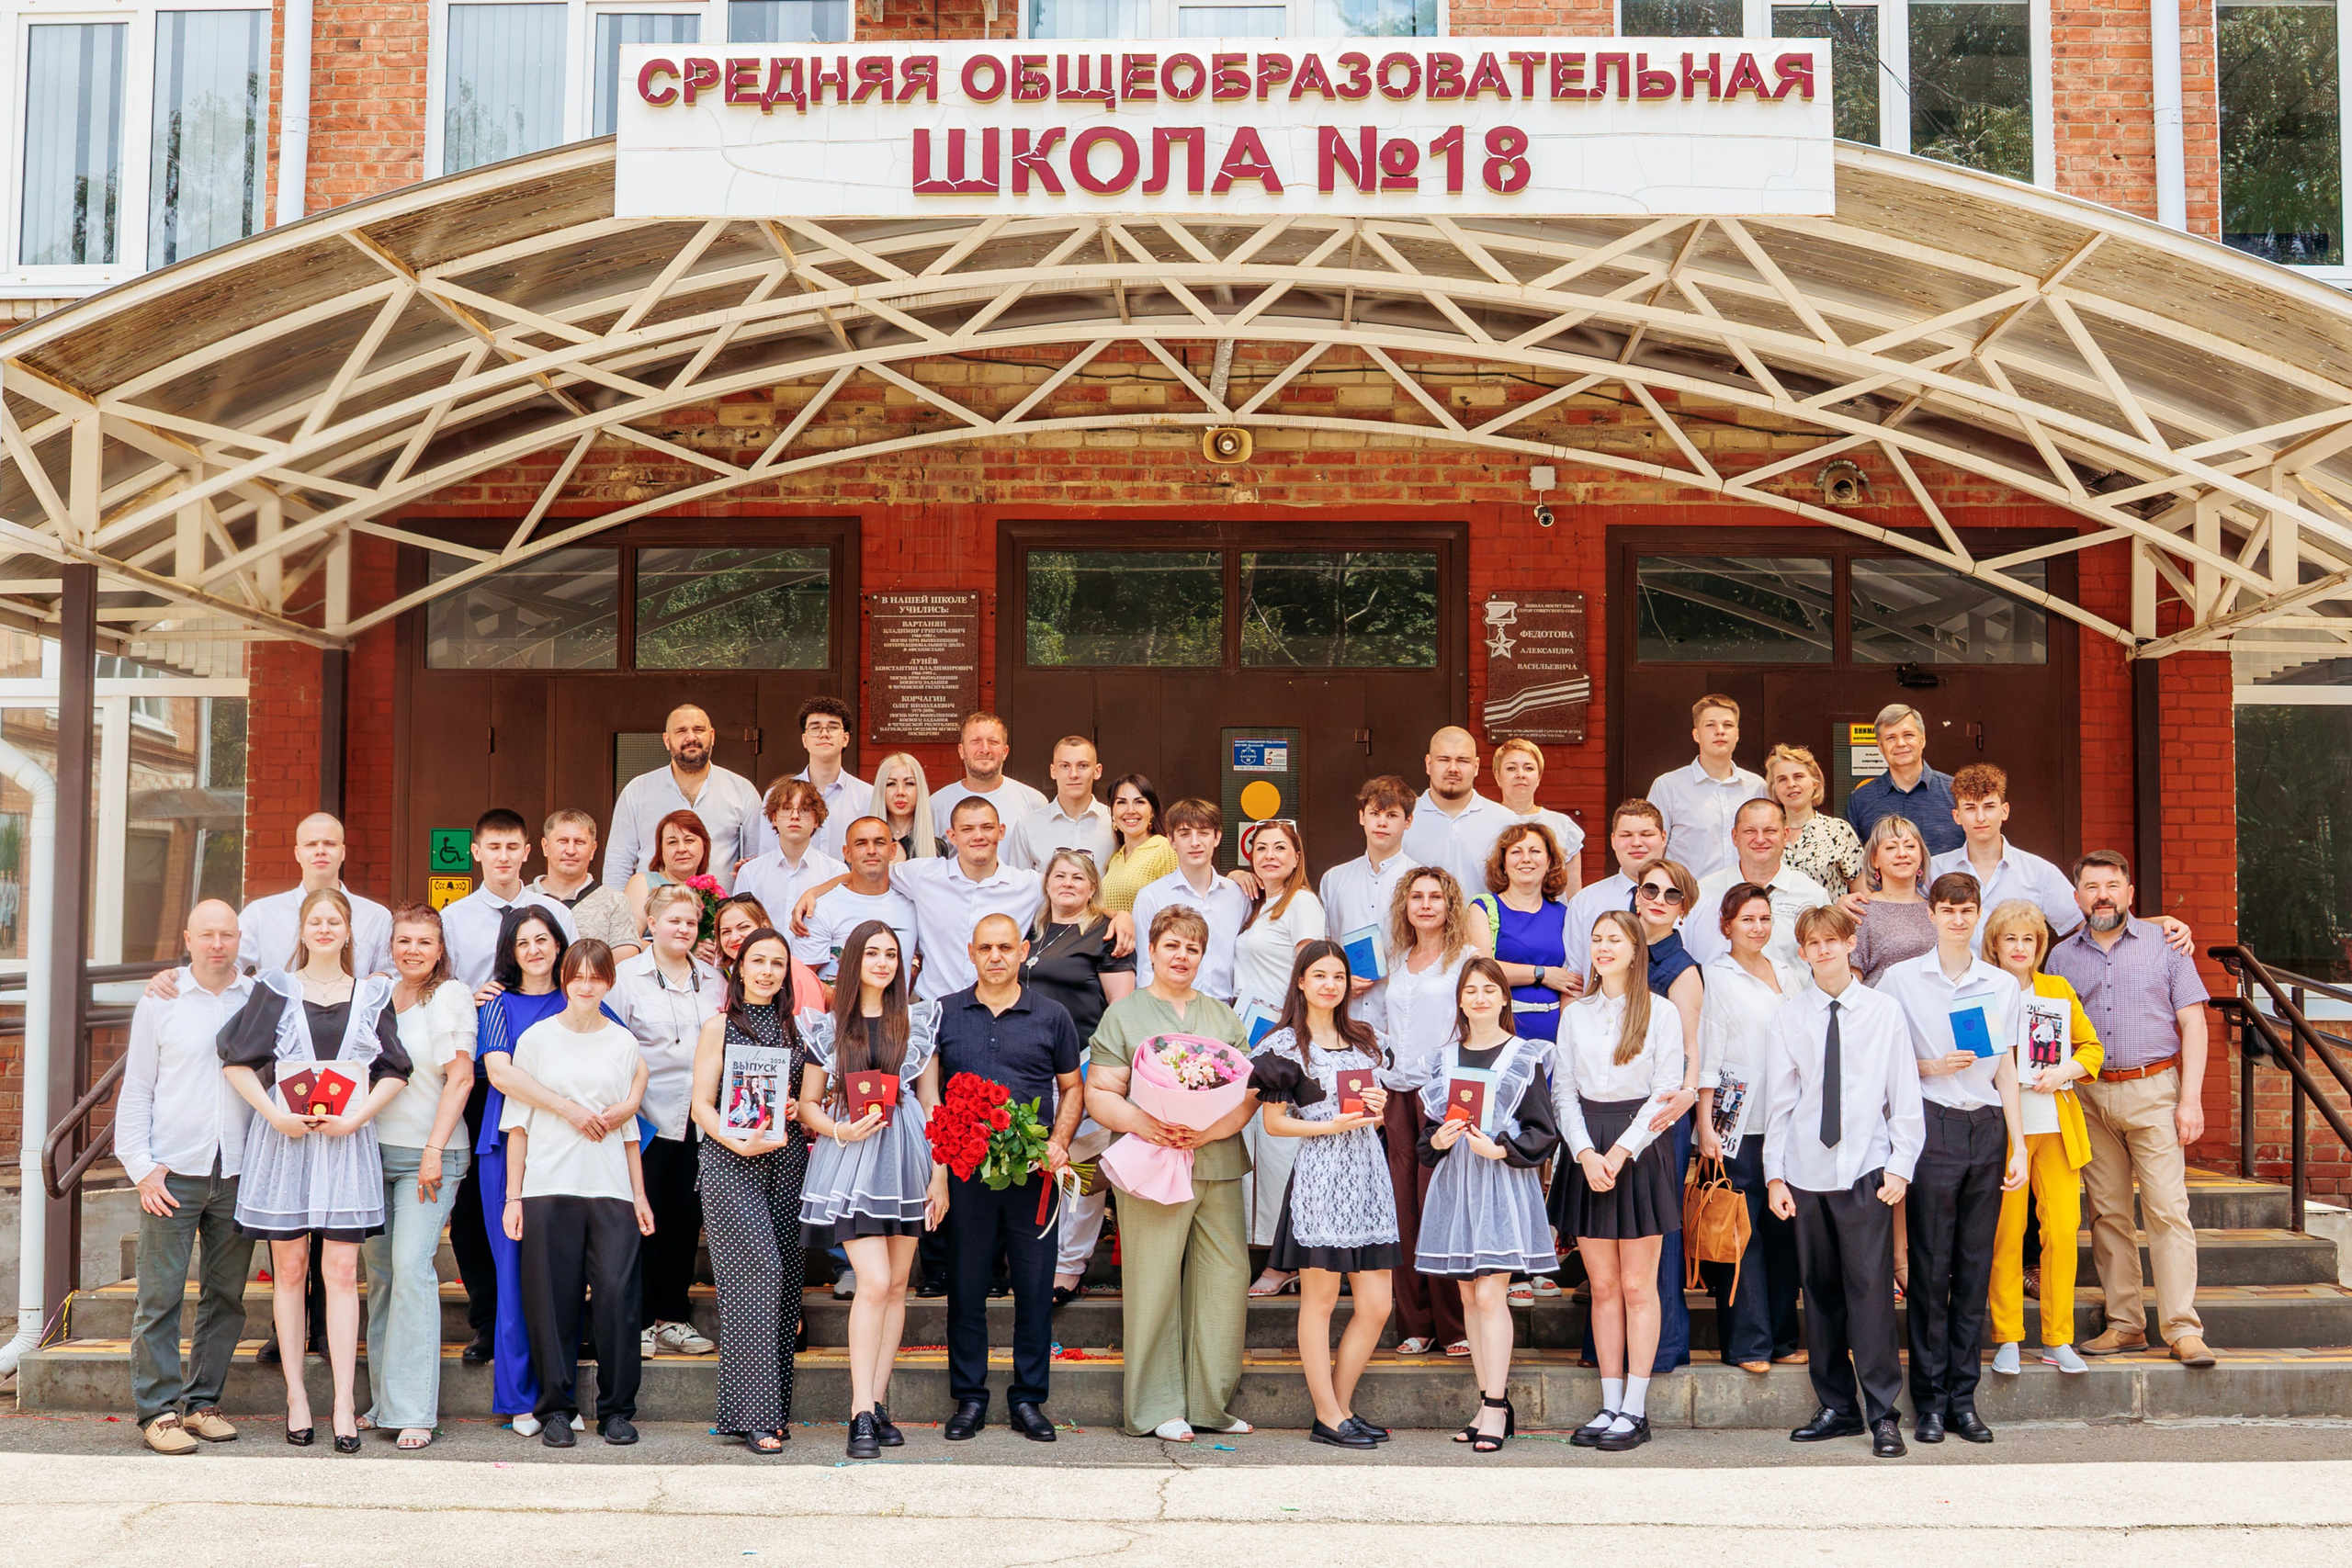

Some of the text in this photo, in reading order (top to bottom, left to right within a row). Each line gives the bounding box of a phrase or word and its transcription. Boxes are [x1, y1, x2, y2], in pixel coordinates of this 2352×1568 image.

[638, 52, 1816, 111] СРЕДНЯЯ ОБЩЕОБРАЗОВАТЕЛЬНАЯ
[912, 125, 1532, 195] ШКОЛА №18
[1520, 630, 1574, 638] ФЕДОТОВА
[732, 1061, 777, 1073] ВЫПУСК
[1721, 1134, 1736, 1152] 26
